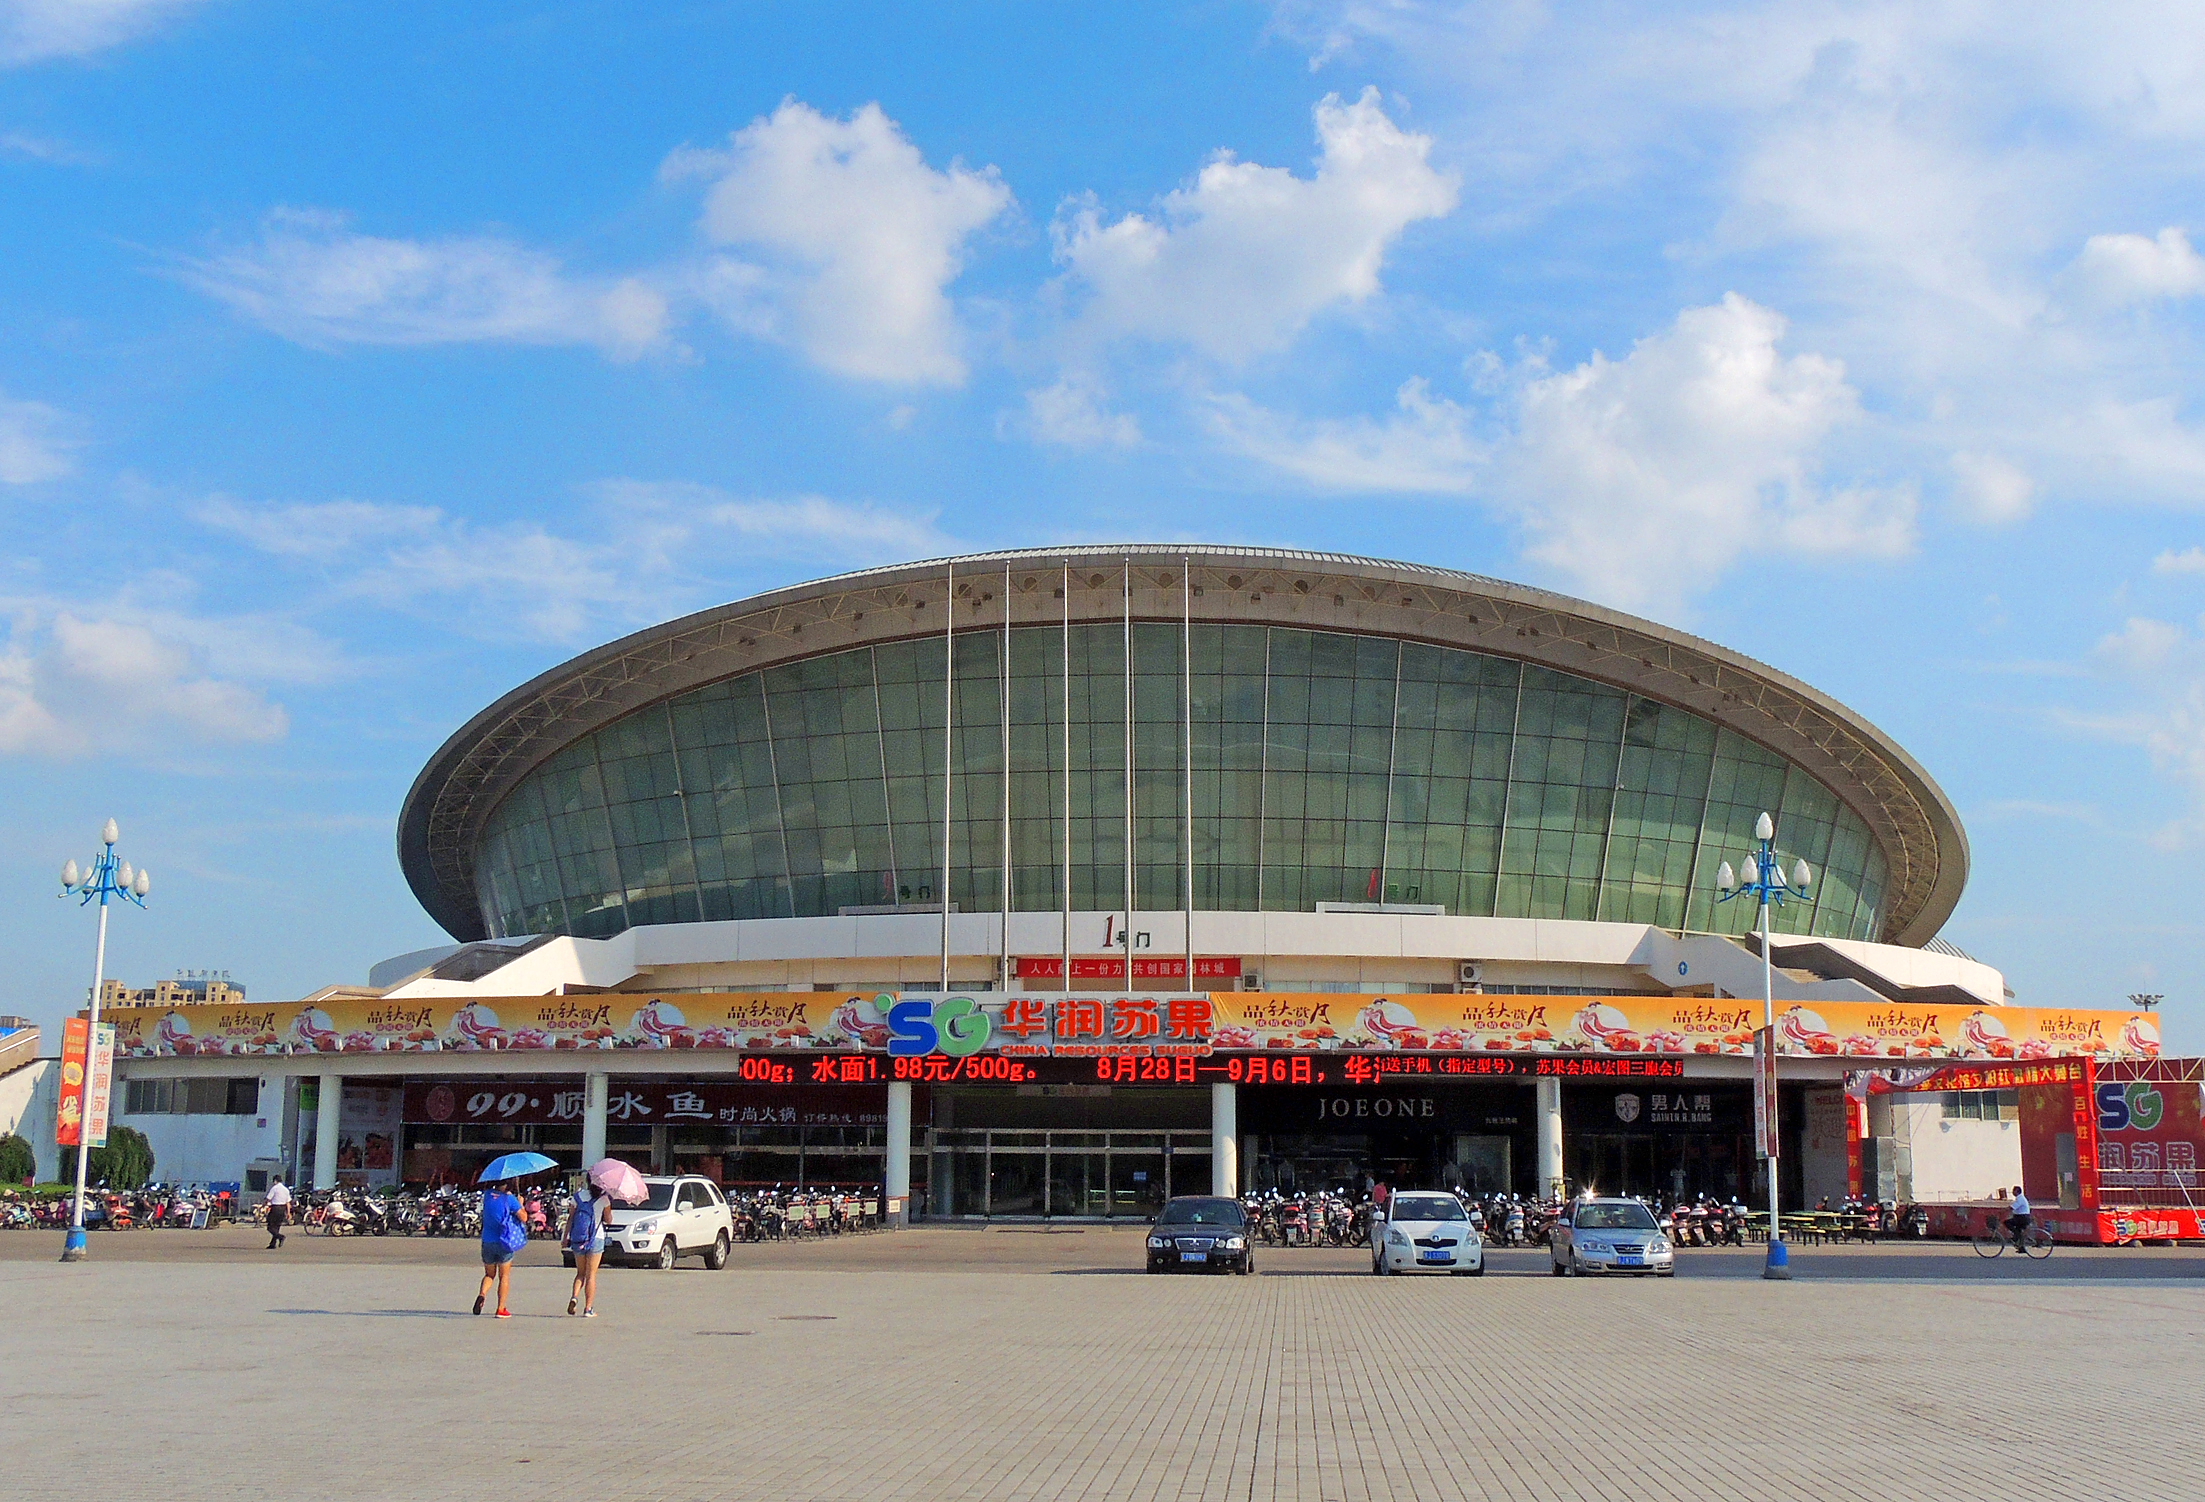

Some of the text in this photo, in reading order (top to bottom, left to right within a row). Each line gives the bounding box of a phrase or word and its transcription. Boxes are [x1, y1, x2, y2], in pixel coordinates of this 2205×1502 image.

[1102, 914, 1151, 948] 1号门
[537, 1002, 611, 1026] 品秋赏月
[727, 999, 808, 1025] 品秋赏月
[1002, 998, 1214, 1039] 华润苏果
[1243, 999, 1331, 1026] 品秋赏月
[1462, 1001, 1548, 1027] 品秋赏月
[1672, 1004, 1755, 1031] 品秋赏月
[1866, 1010, 1940, 1036] 品秋赏月
[887, 997, 993, 1057] SG
[2040, 1014, 2103, 1040] 品秋赏月
[1001, 1045, 1050, 1056] CHINA
[1052, 1045, 1152, 1057] RESOURCES
[719, 1106, 797, 1123] 时尚火锅
[1318, 1098, 1435, 1120] JOEONE
[1651, 1094, 1711, 1111] 男人帮
